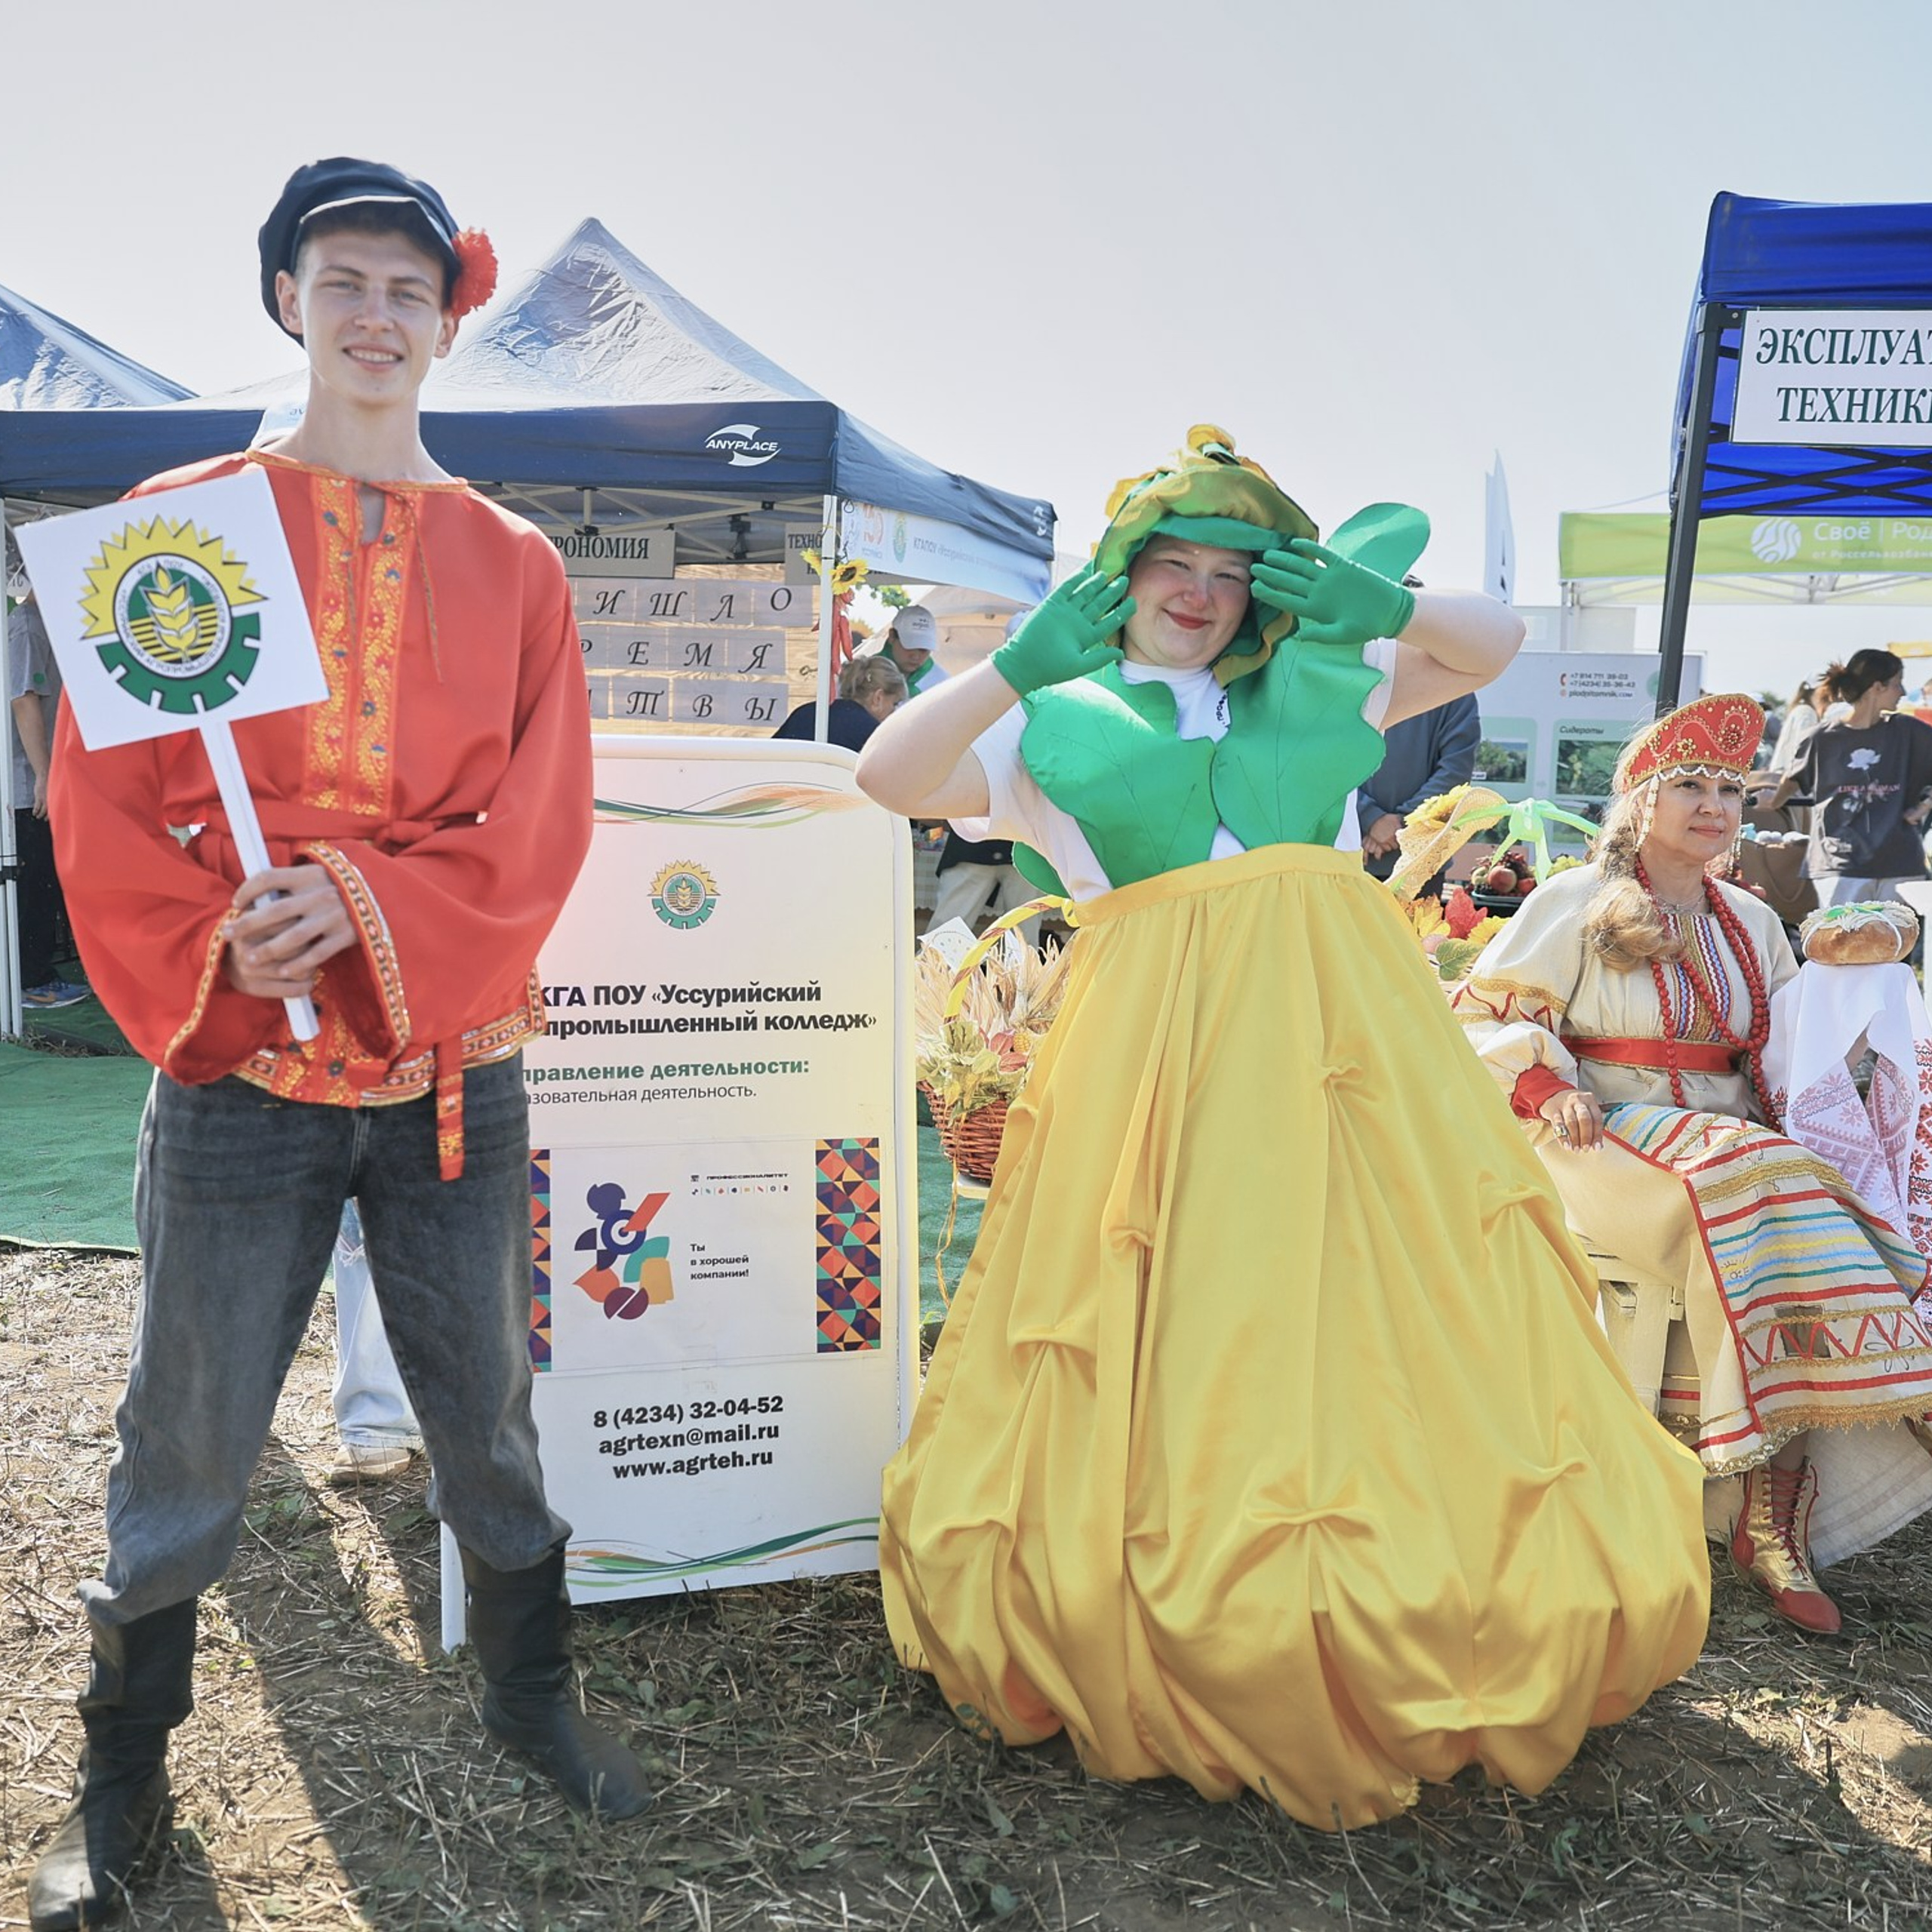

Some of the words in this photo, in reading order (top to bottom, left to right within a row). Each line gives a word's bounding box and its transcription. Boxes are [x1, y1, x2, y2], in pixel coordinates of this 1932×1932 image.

[1756, 328, 1932, 365] ЭКСПЛУА
[1777, 387, 1932, 423] ТЕХНИК
[706, 439, 778, 451] ANYPLACE
[1814, 521, 1871, 541] Своё
[593, 984, 647, 1006] ПОУ
[652, 980, 821, 1008] «Уссурийский
[764, 1014, 877, 1032] колледж»
[651, 1060, 809, 1080] деятельности:
[641, 1085, 757, 1103] деятельность.
[691, 1243, 705, 1252] Ты
[700, 1255, 749, 1266] хорошей
[691, 1269, 749, 1280] компании!
[593, 1411, 608, 1428] 8
[614, 1404, 684, 1429] (4234)
[690, 1395, 783, 1419] 32-04-52
[599, 1424, 779, 1457] agrtexn@mail.ru
[613, 1451, 773, 1479] www.agrteh.ru
